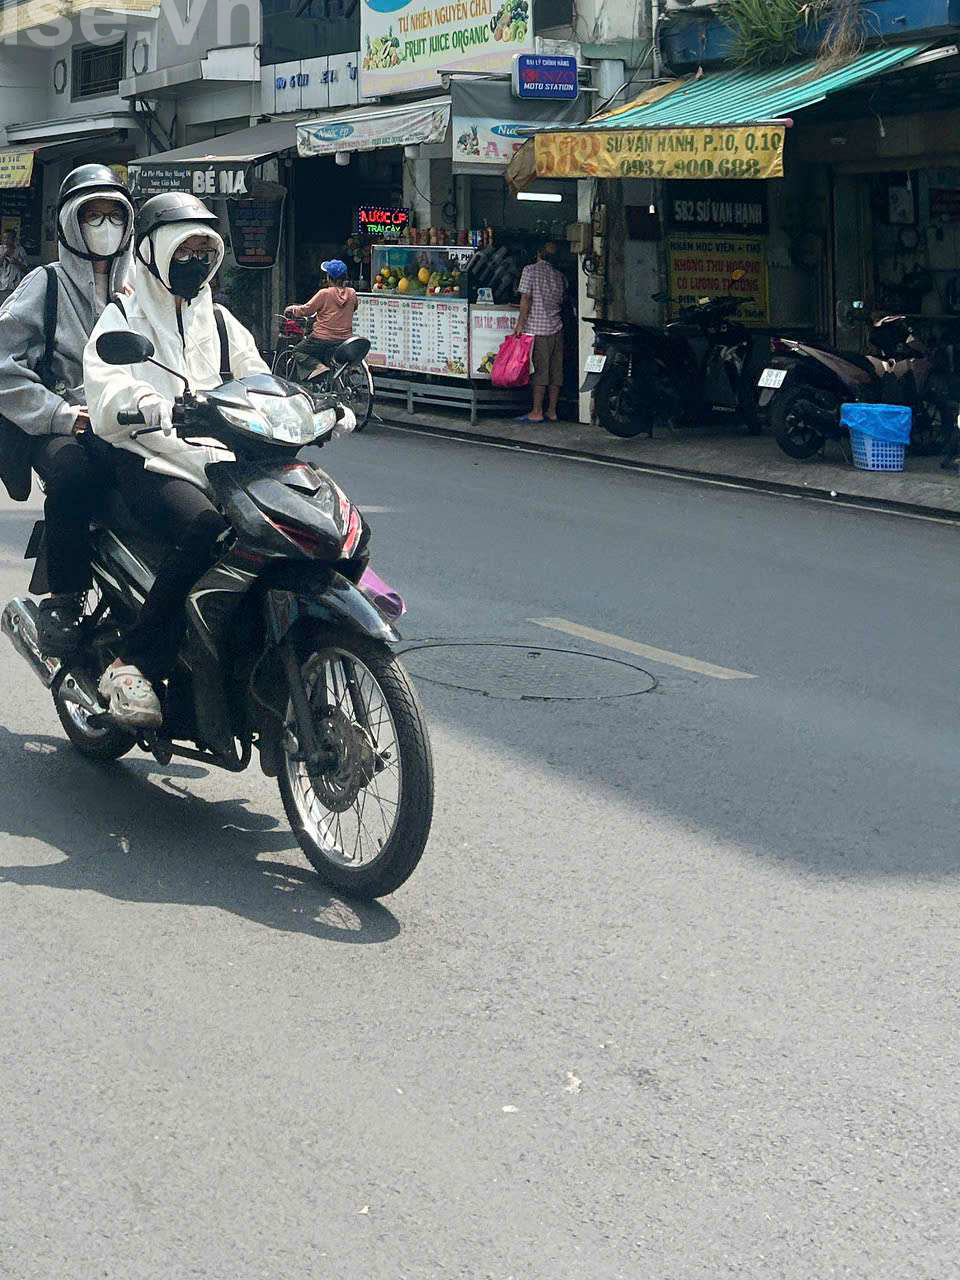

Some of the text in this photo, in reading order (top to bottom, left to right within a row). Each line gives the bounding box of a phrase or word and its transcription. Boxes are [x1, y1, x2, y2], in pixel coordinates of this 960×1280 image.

[411, 6, 433, 31] NHIÊN
[402, 24, 489, 62] FRUIT JUICE ORGANIC
[524, 82, 574, 91] MOTO STATION
[745, 132, 782, 154] Q.10
[193, 165, 248, 194] BÉ NA
[675, 200, 695, 221] 582
[367, 223, 400, 232] TRÁI CÂY
